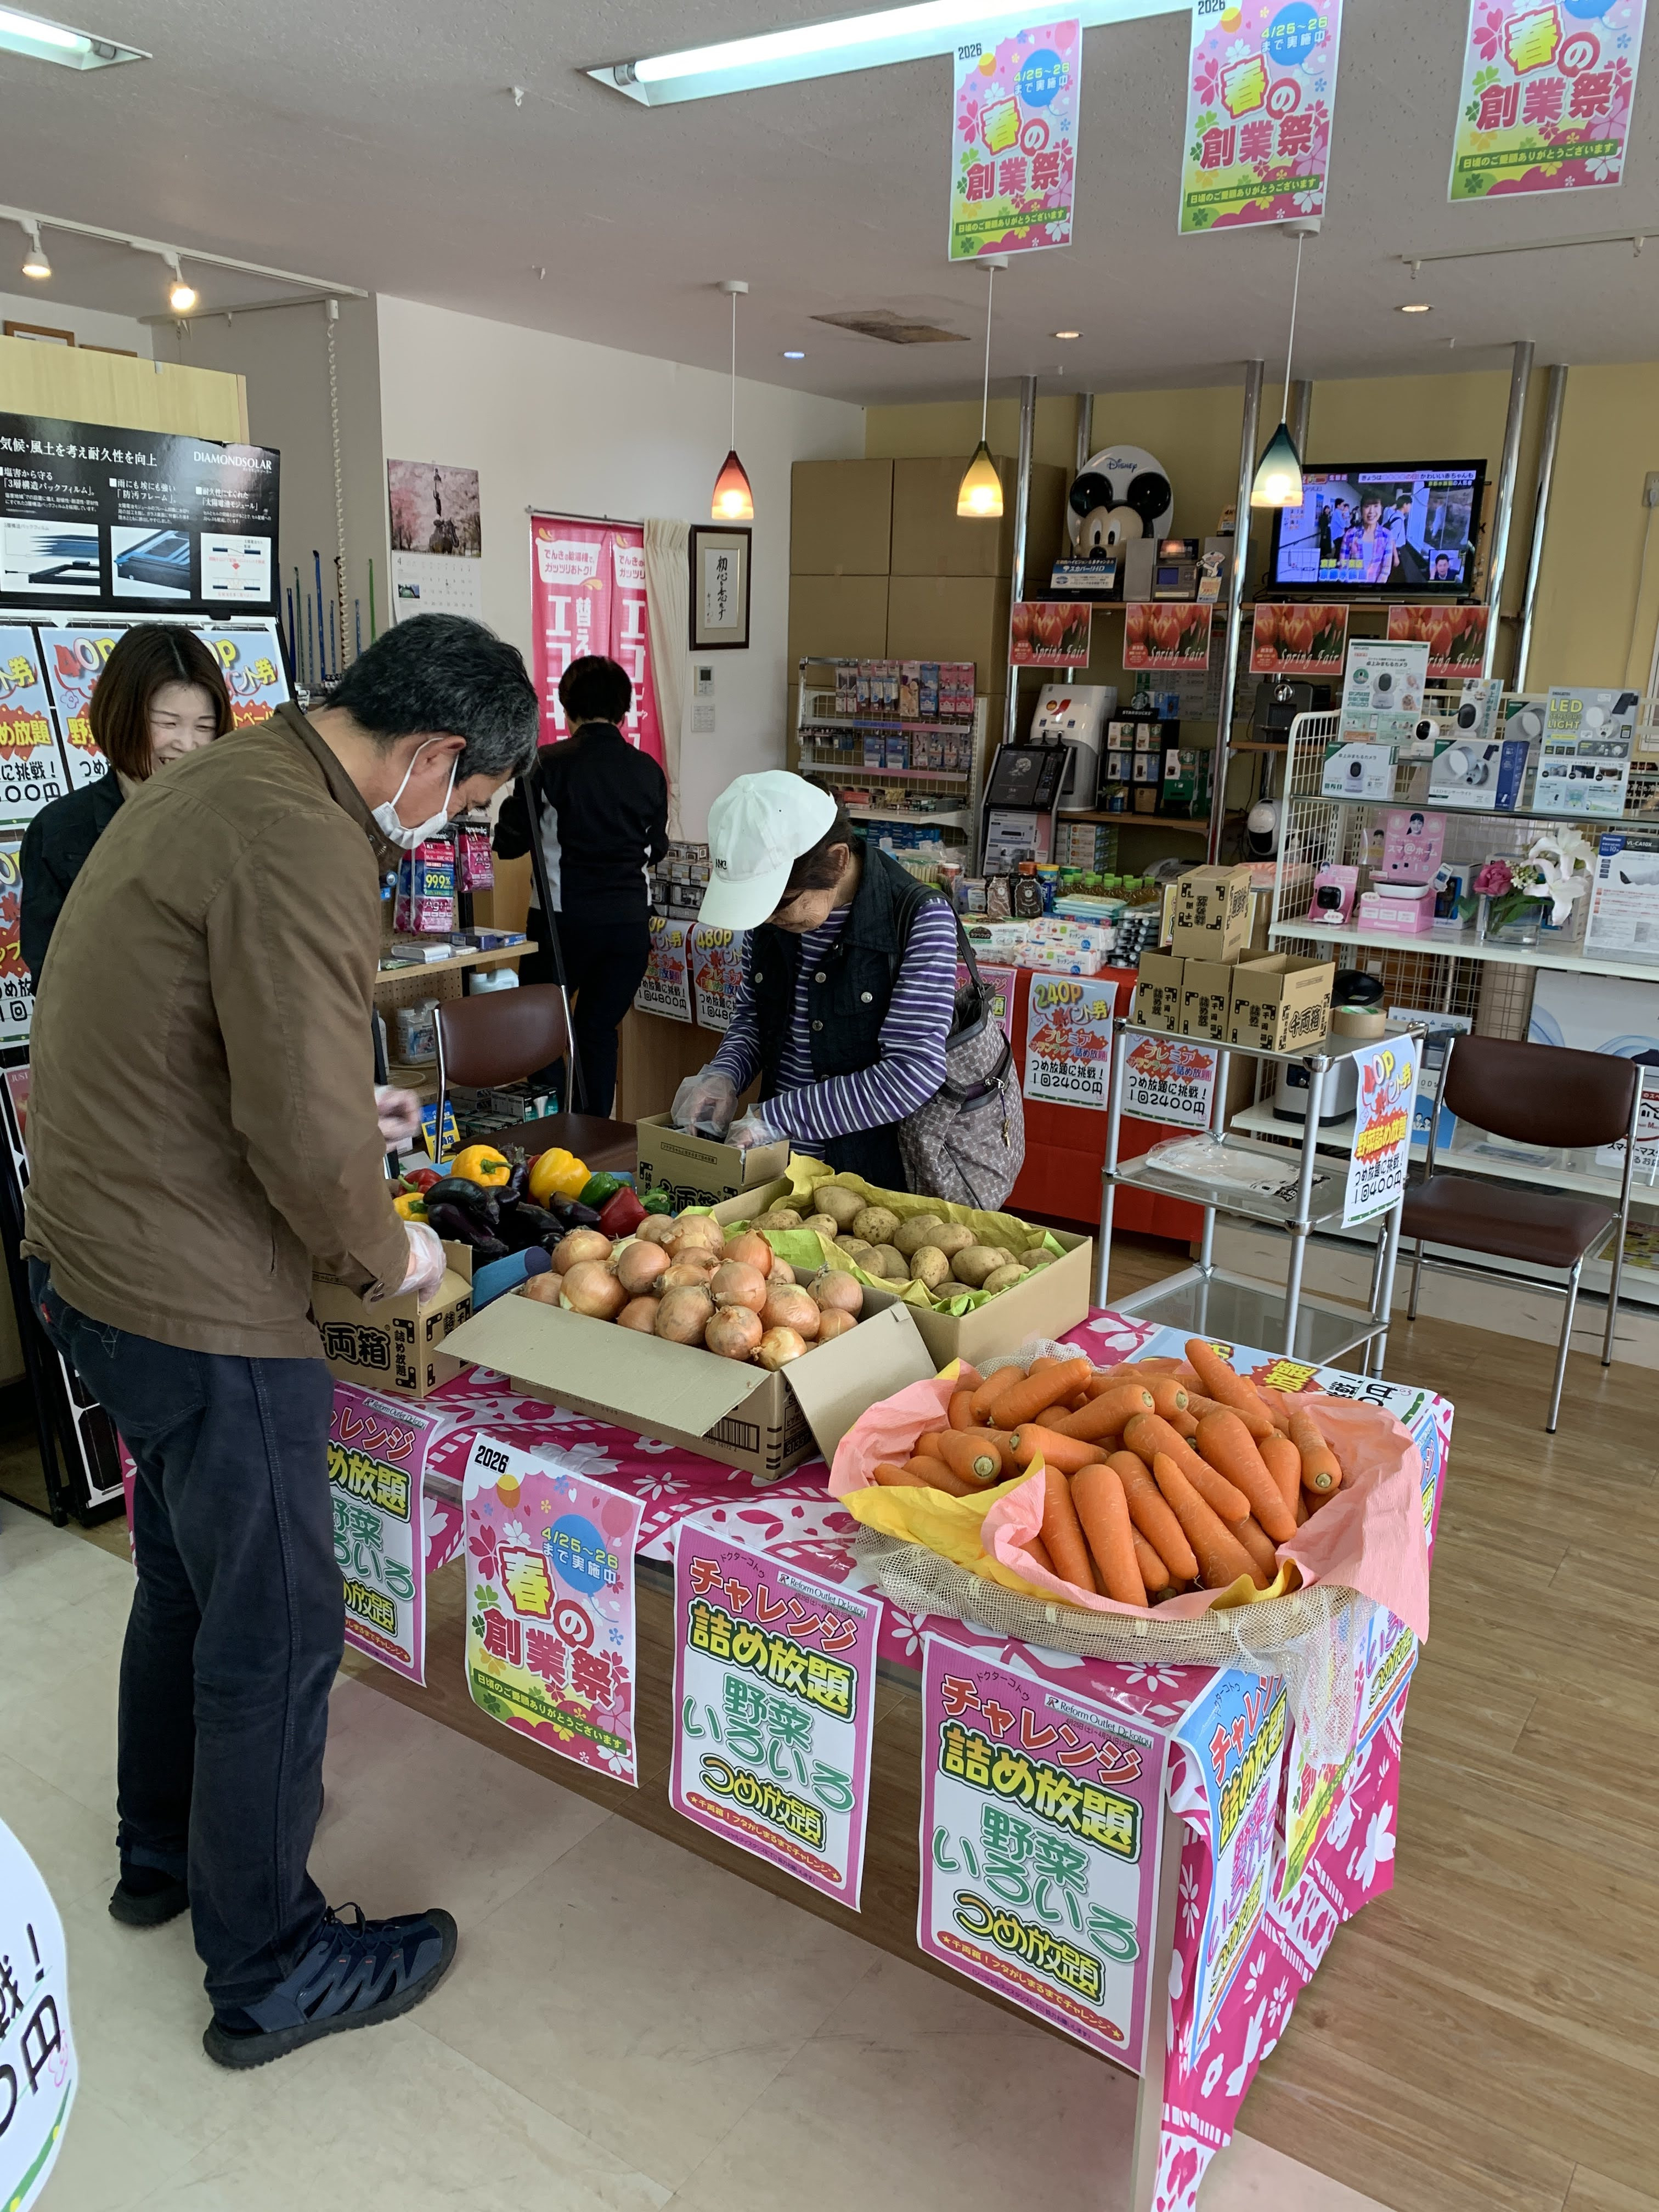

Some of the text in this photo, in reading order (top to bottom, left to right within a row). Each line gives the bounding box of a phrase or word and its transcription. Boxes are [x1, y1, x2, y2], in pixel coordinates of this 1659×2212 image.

[958, 43, 982, 60] 2026
[1261, 31, 1325, 53] まで実施中
[1504, 5, 1600, 77] 春の
[1014, 75, 1068, 95] まで実施中
[1218, 53, 1301, 120] 春の
[1476, 71, 1615, 133] 創業祭
[979, 96, 1049, 157] 春の
[1200, 111, 1317, 170] 創業祭
[965, 150, 1064, 202] 創業祭
[4, 467, 53, 481] 塩害から守る
[194, 450, 272, 471] DIAMONDSOLAR
[1032, 644, 1062, 663] Spring
[1065, 644, 1085, 661] Fair
[1149, 646, 1179, 666] Spring
[1182, 647, 1205, 663] Fair
[1279, 648, 1312, 670] Spring
[1315, 650, 1340, 667] Fair
[1454, 653, 1480, 672] Fair
[1547, 720, 1581, 731] LIGHT
[1550, 698, 1583, 713] LED
[697, 928, 733, 949] 480P
[1034, 980, 1084, 1008] 240P
[1032, 1074, 1103, 1094] 1回2400円
[1129, 1089, 1205, 1115] 1回2400円
[1357, 1114, 1408, 1158] 野菜詰め放題
[393, 1329, 407, 1377] 詰め放題
[373, 1401, 390, 1413] Reform
[390, 1408, 405, 1419] Outlet
[475, 1445, 509, 1474] 2026
[543, 1541, 617, 1584] まで実施中
[720, 1552, 766, 1578] ドクターコトウ
[499, 1546, 594, 1649] 春の
[690, 1556, 858, 1652] チャレンジ
[791, 1578, 814, 1594] Reform
[815, 1589, 836, 1604] Outlet
[483, 1608, 614, 1708] 創業祭
[690, 1600, 854, 1719] 詰め放題
[976, 1671, 1030, 1702] ドクターコトウ
[477, 1673, 622, 1750] 日頃のご愛顧ありがとうございます
[724, 1675, 813, 1752] 野菜
[940, 1674, 1144, 1787] チャレンジ
[1060, 1702, 1088, 1720] Reform
[1090, 1714, 1116, 1731] Outlet
[682, 1695, 855, 1813] いろいろ
[1219, 1687, 1287, 1859] 詰め放題
[699, 1753, 826, 1852] つめ放題
[940, 1723, 1141, 1858] 詰め放題
[980, 1802, 1091, 1892] 野菜
[932, 1825, 1141, 1962] いろいろ
[952, 1889, 1105, 2005] つめ放題
